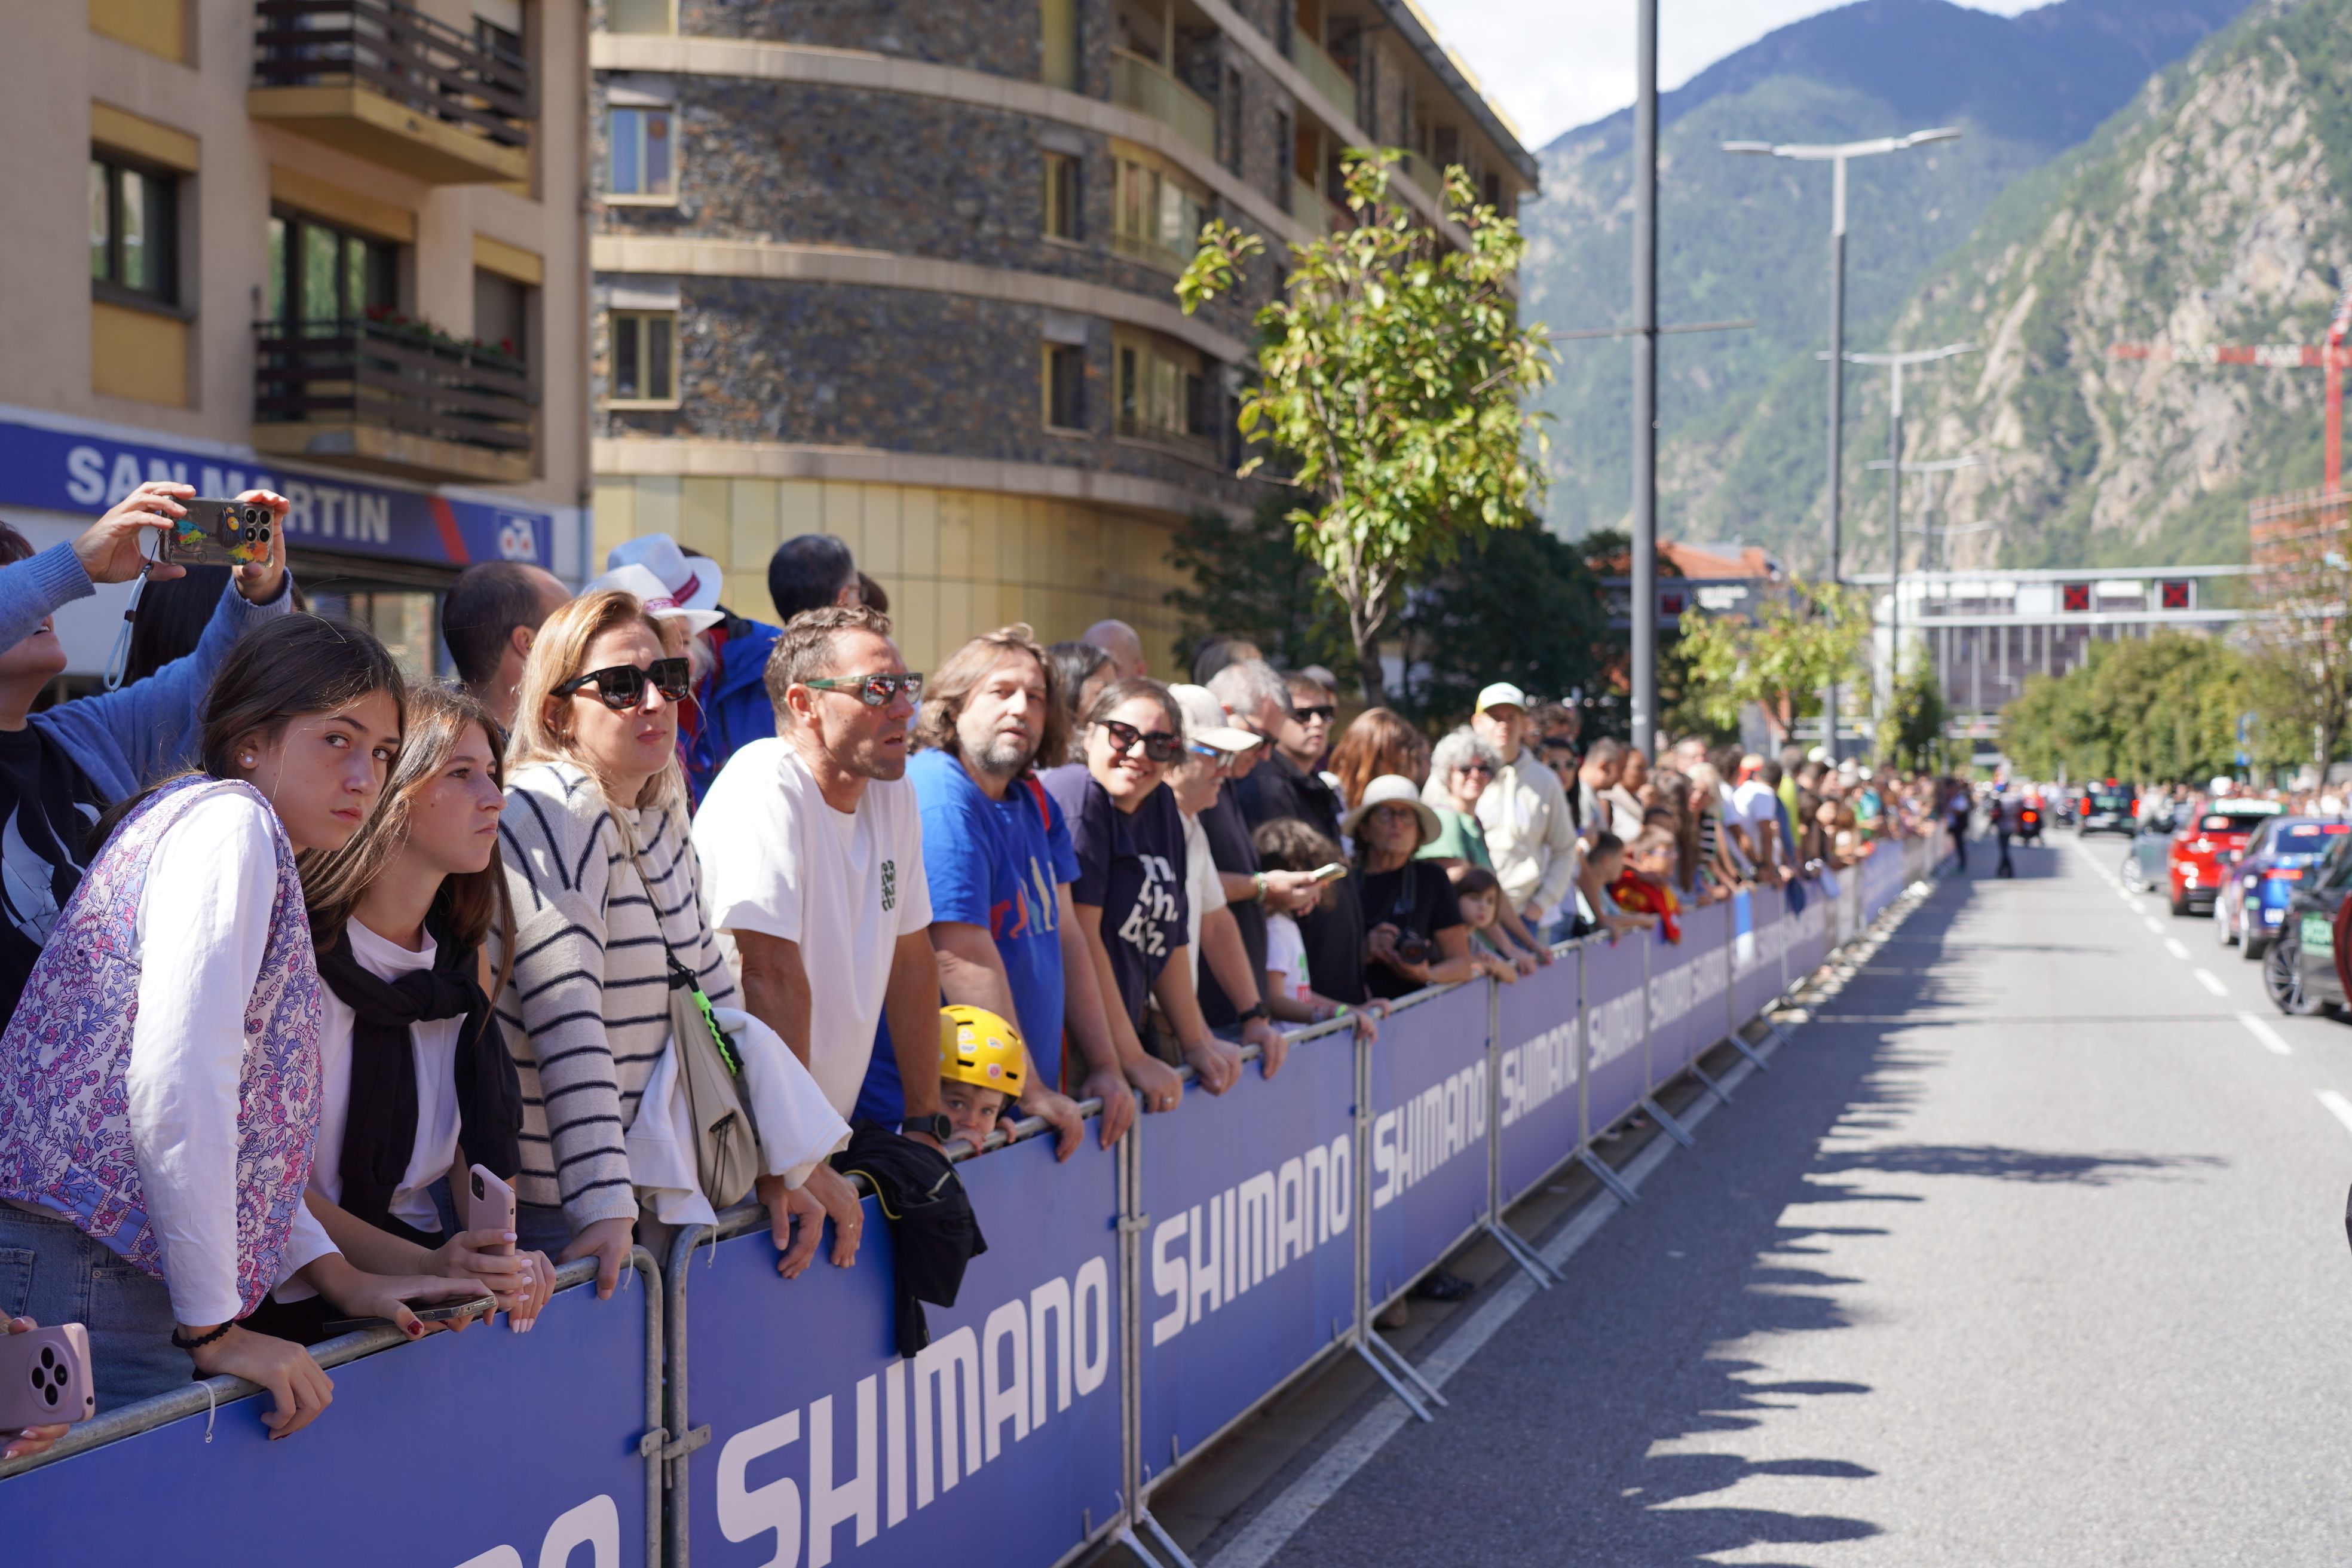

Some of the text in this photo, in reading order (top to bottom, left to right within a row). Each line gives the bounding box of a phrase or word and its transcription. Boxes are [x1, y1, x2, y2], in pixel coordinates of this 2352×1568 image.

[202, 466, 390, 544] MRTIN
[1373, 1058, 1487, 1211] SHIMANO
[1500, 1017, 1579, 1128] SHIMANO
[1152, 1133, 1351, 1348] SHIMANO
[717, 1255, 1109, 1568] SHIMANO
